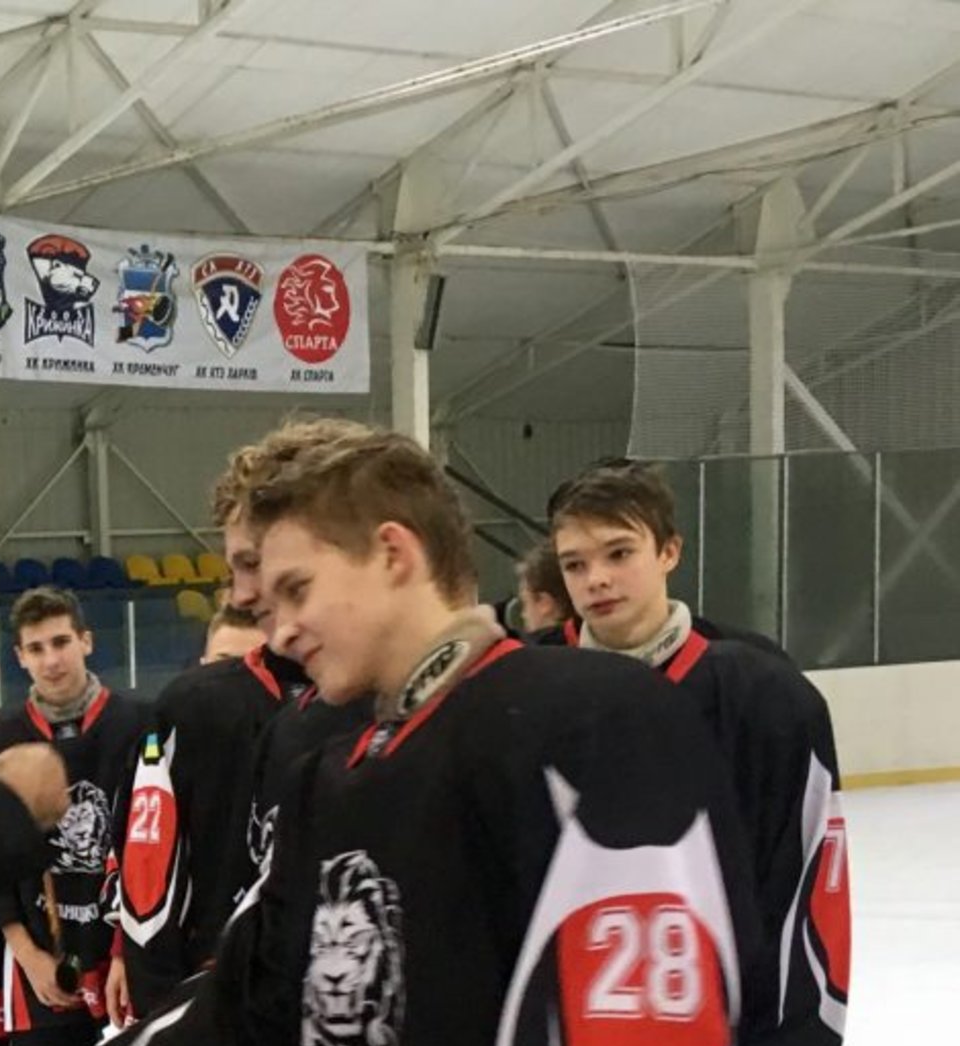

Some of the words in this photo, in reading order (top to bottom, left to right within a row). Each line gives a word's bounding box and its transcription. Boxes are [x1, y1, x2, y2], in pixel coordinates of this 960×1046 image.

[285, 335, 337, 350] СПАРТА
[129, 793, 161, 844] 22
[582, 905, 703, 1022] 28
